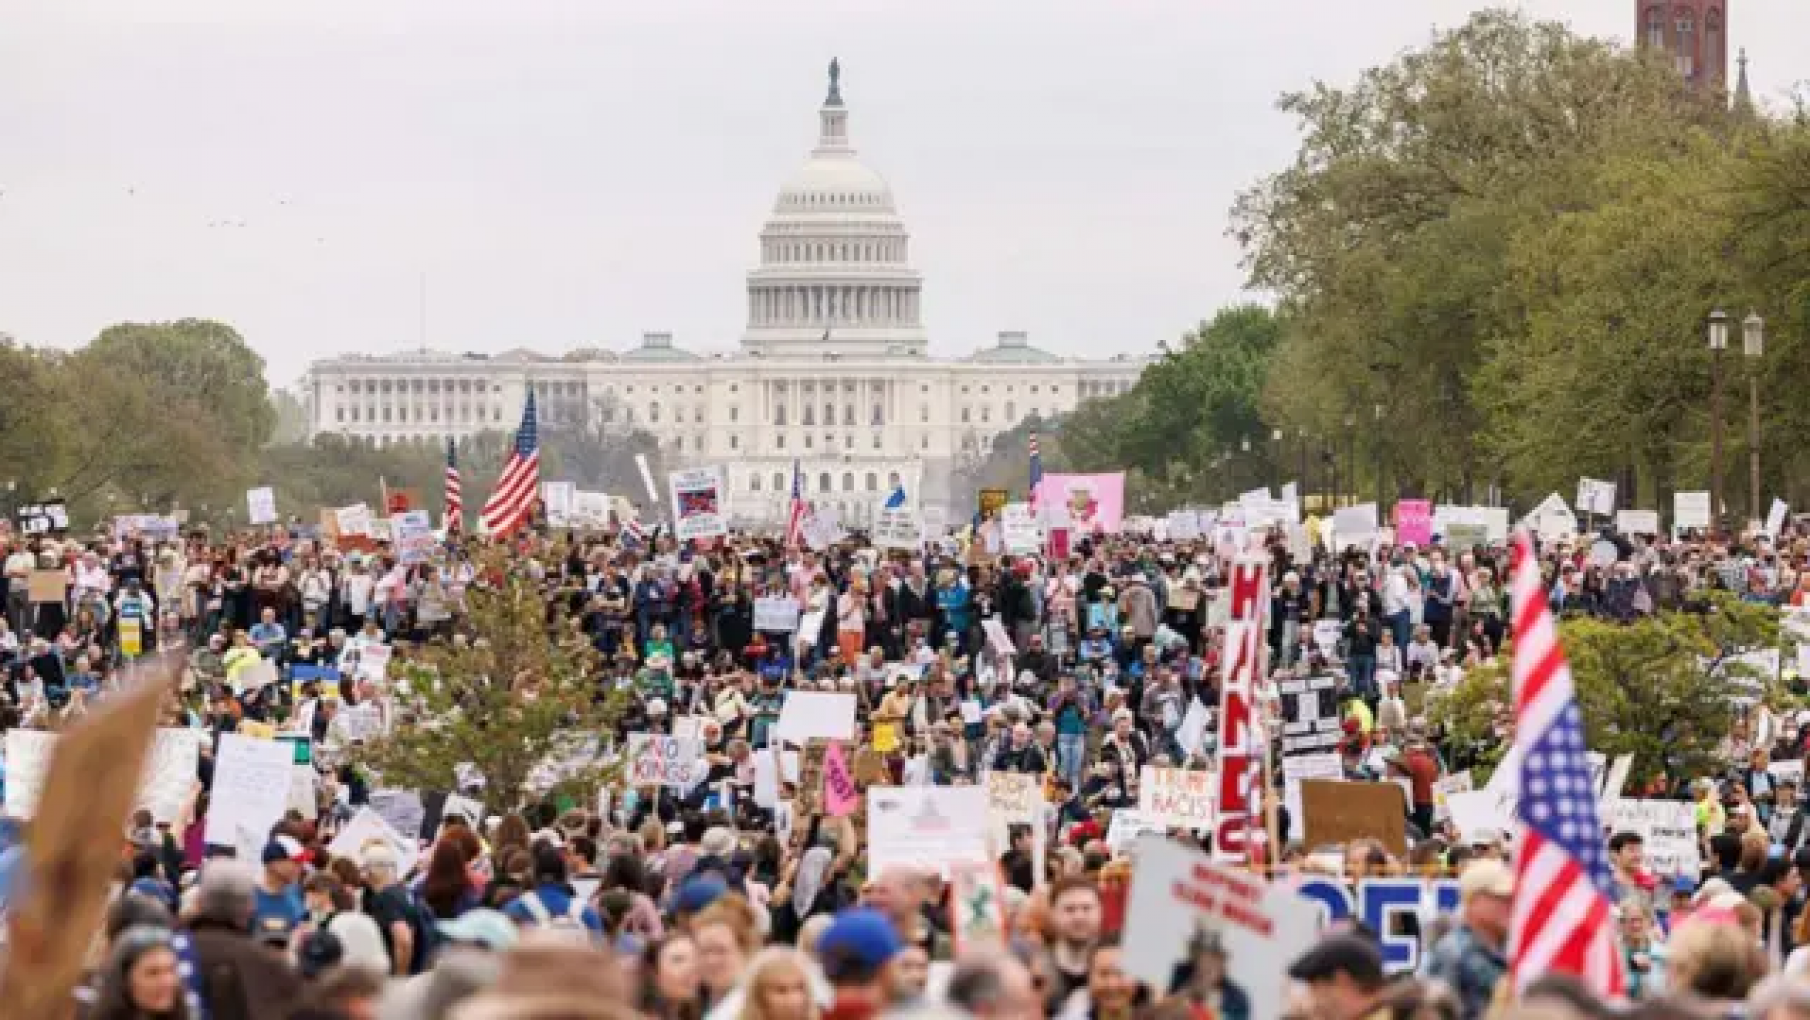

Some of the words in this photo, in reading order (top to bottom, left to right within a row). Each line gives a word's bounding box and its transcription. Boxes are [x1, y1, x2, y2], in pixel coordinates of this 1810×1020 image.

[643, 737, 679, 759] NO
[634, 758, 691, 783] KINGS
[1152, 794, 1216, 820] RACIST
